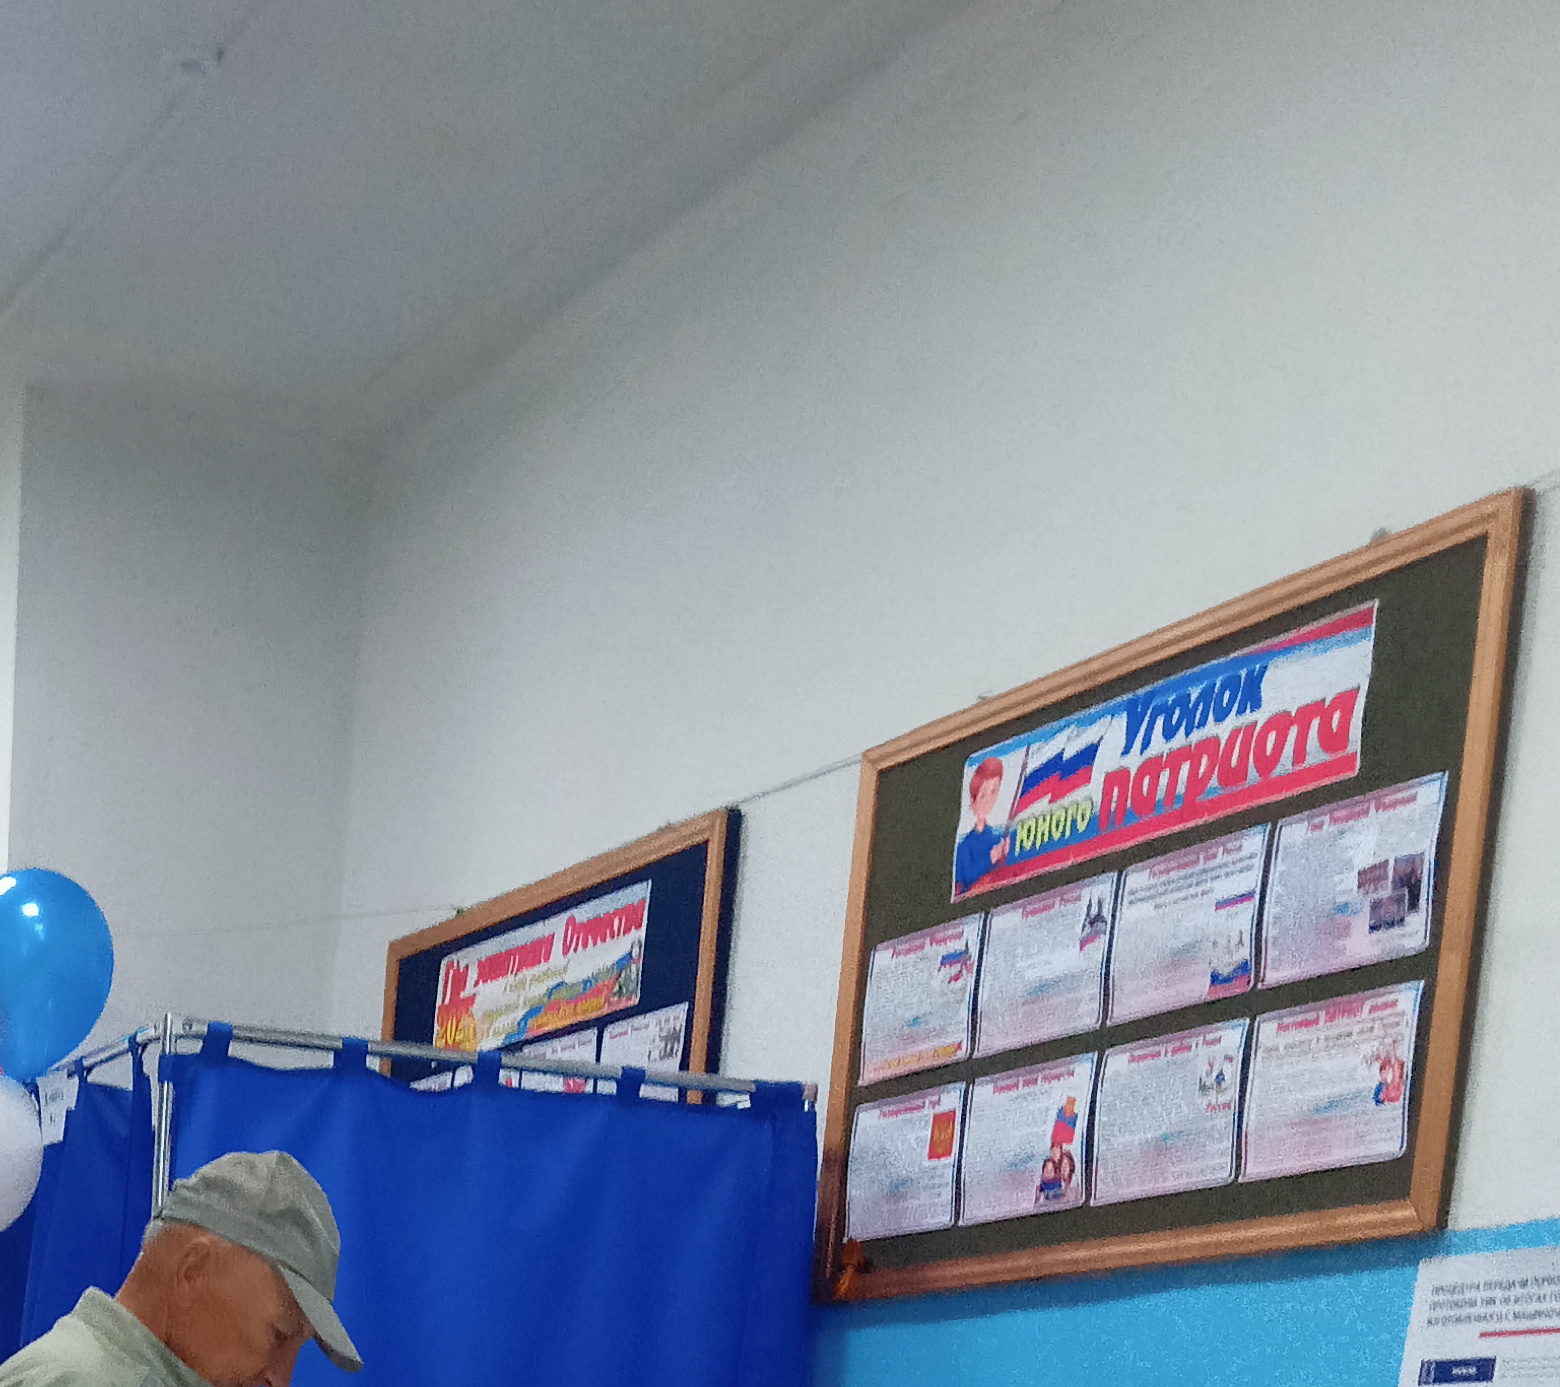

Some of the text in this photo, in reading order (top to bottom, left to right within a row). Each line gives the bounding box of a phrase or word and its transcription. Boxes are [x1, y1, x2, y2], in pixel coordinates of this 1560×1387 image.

[1014, 800, 1094, 857] юного
[1097, 684, 1361, 836] патриота
[1121, 664, 1270, 757] Уголок
